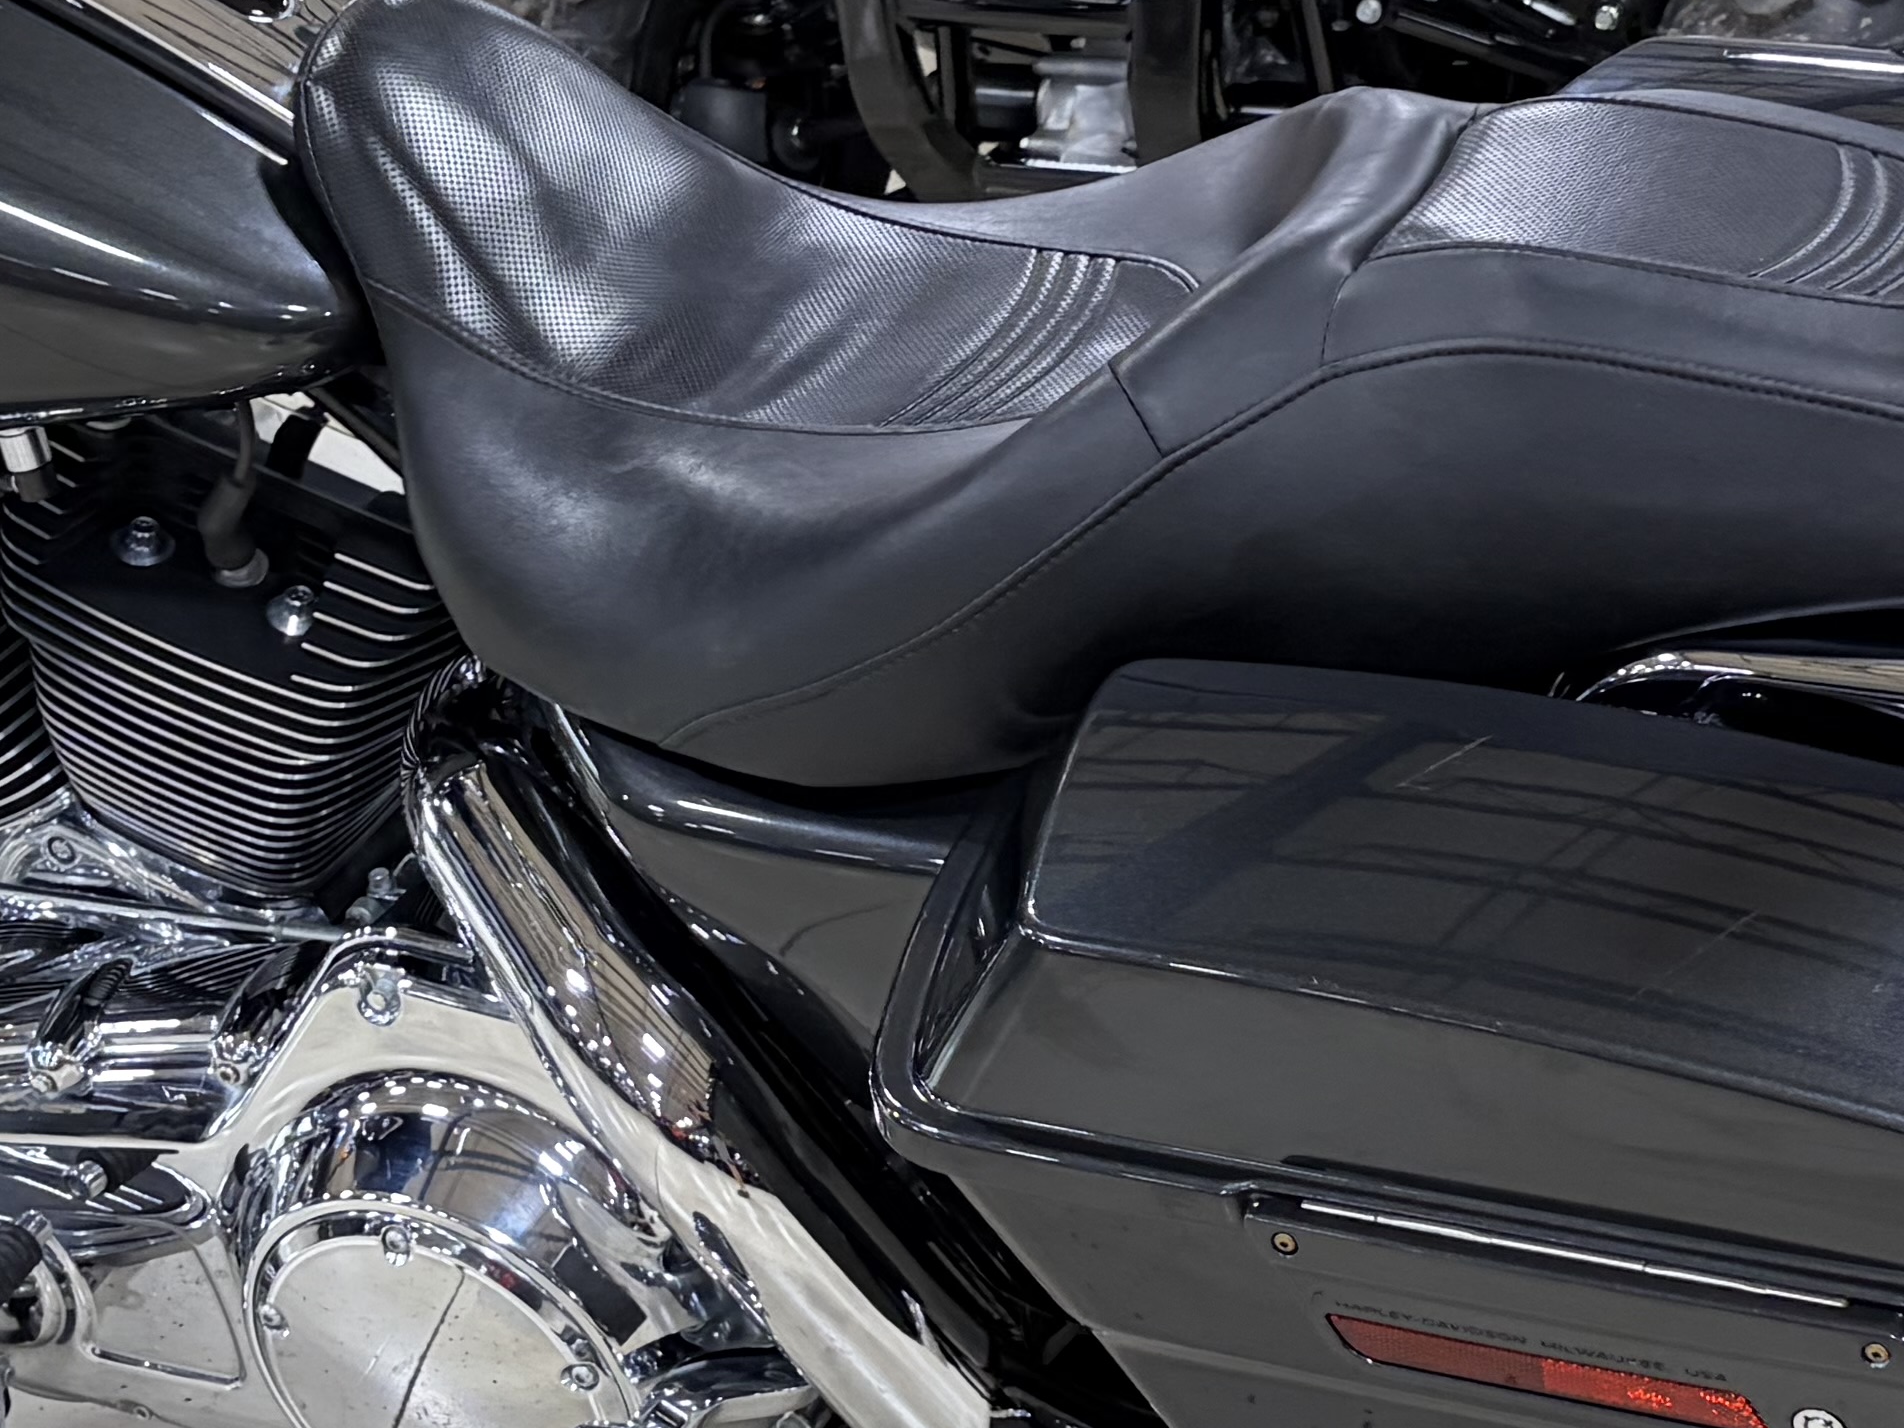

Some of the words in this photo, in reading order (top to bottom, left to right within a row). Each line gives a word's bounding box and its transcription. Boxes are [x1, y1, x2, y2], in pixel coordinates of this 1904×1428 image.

[1334, 1299, 1529, 1346] HARLEY-DAVIDSON
[1540, 1338, 1667, 1372] MILWAUKEE
[1684, 1367, 1728, 1383] USA
